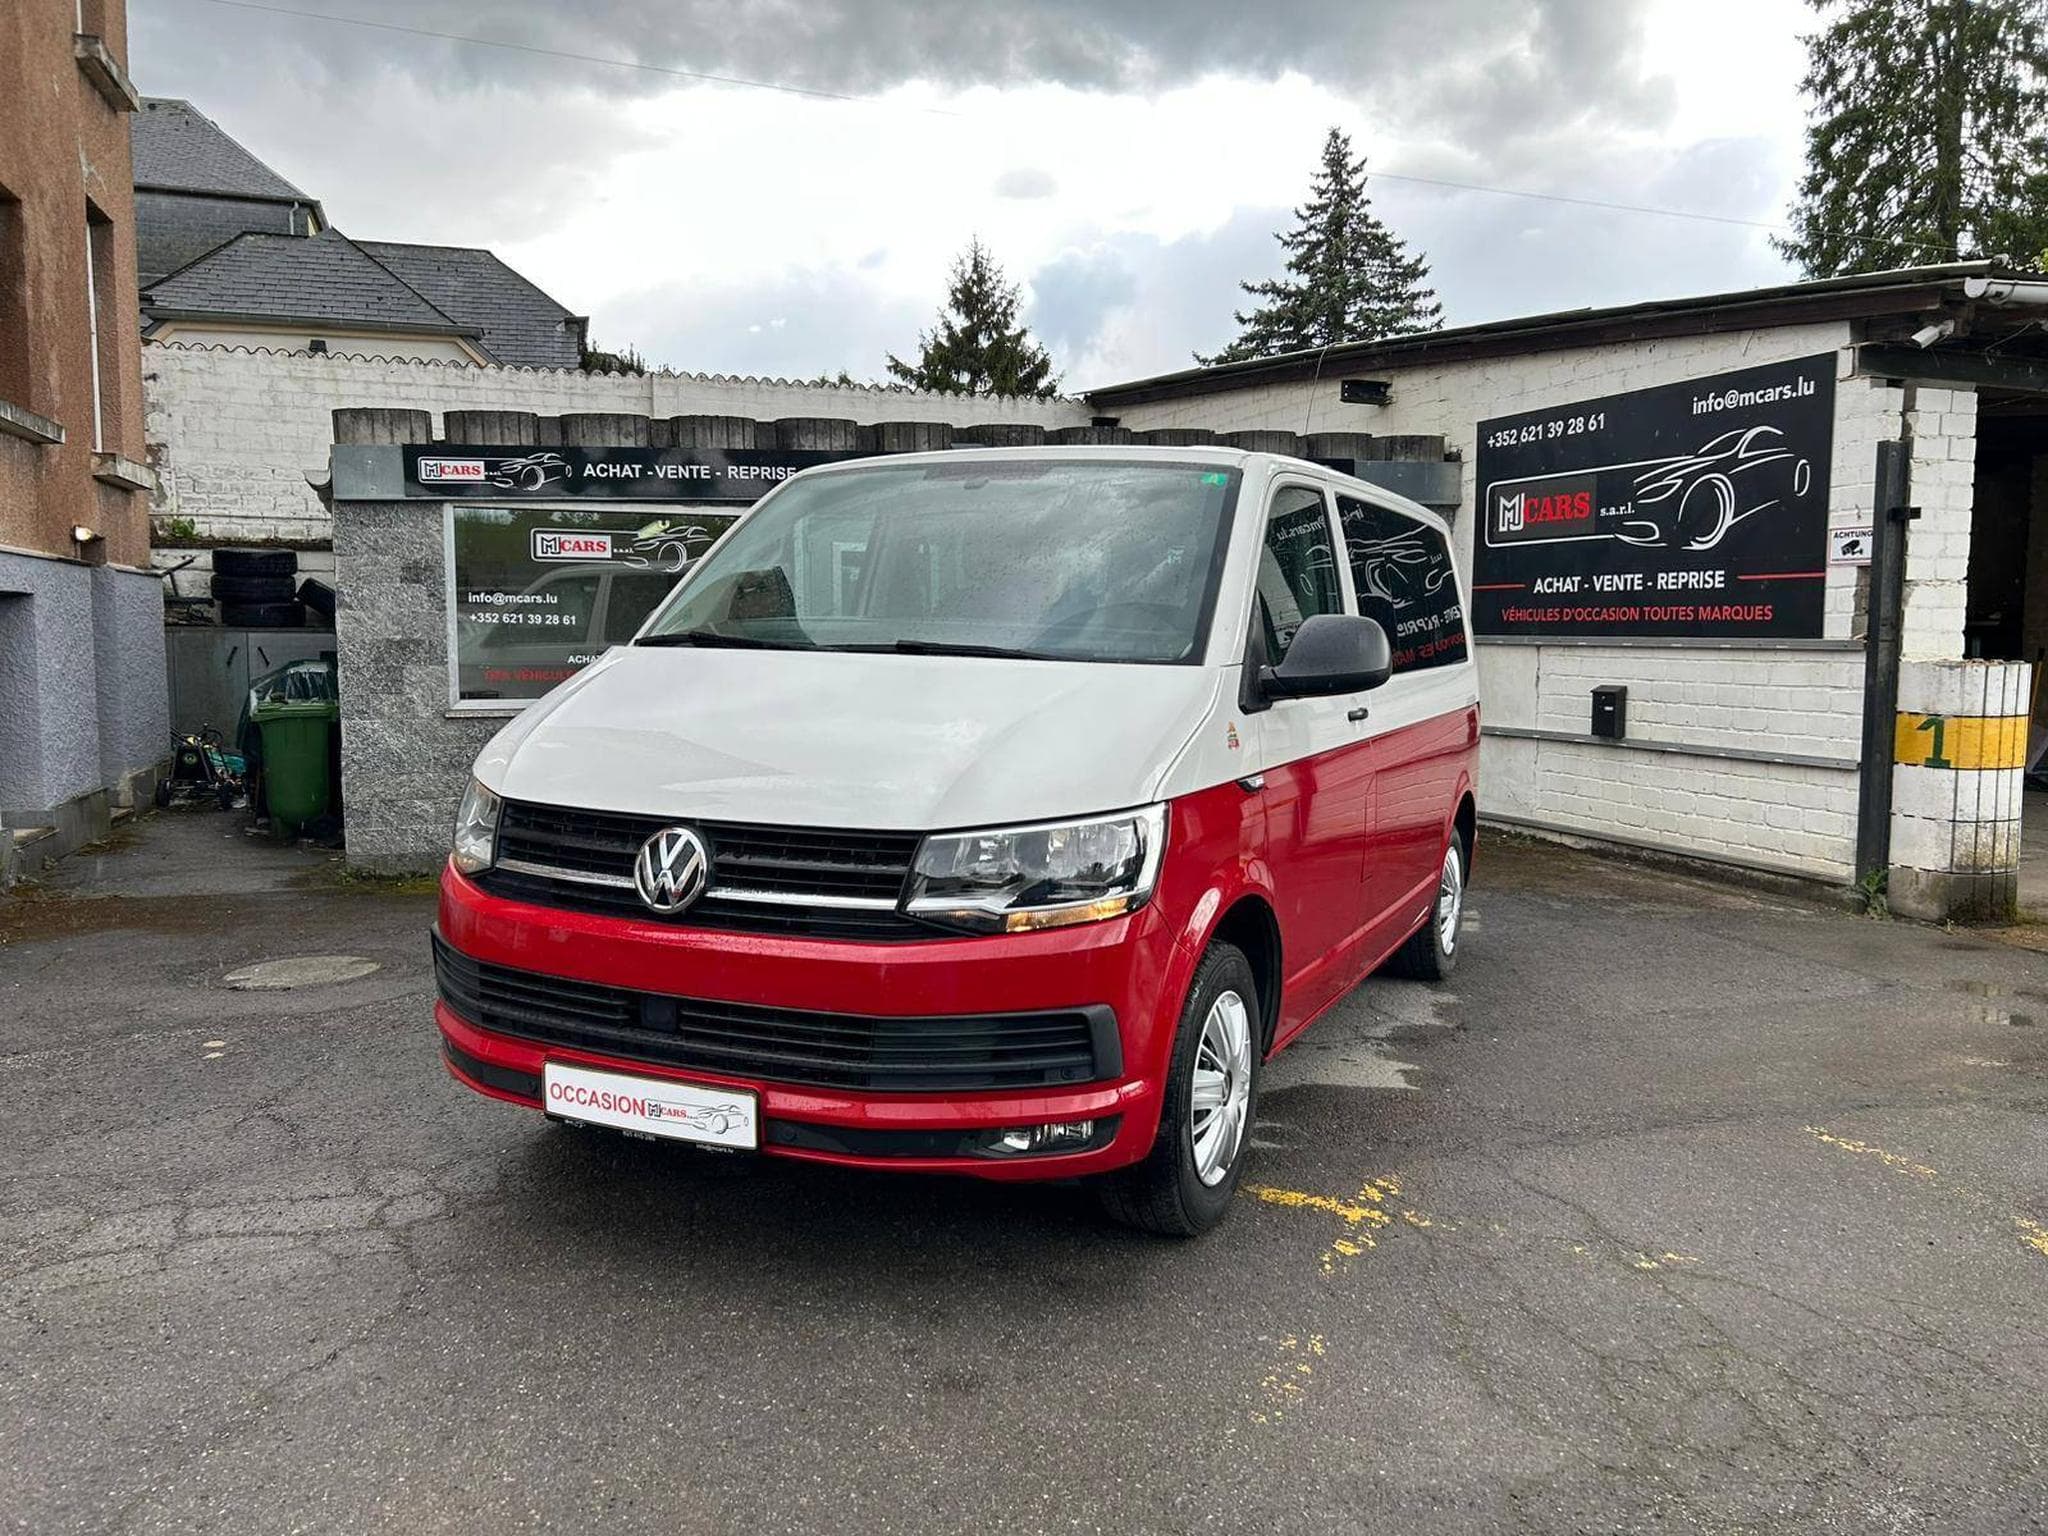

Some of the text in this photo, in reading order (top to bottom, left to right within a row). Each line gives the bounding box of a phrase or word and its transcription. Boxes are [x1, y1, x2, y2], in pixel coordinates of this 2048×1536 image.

[1692, 376, 1815, 415] info@mcars.lu
[1487, 412, 1605, 448] +352 621 39 28 61
[442, 463, 481, 476] CARS
[583, 463, 643, 478] ACHAT
[655, 464, 711, 479] VENTE
[728, 465, 797, 480] REPRISE
[1525, 491, 1590, 523] CARS
[1600, 502, 1635, 516] s.a.r.l.
[1834, 530, 1874, 539] ACHTUNG
[560, 540, 607, 553] CARS
[1533, 576, 1581, 594] ACHAT
[1593, 574, 1643, 592] VENTE
[1657, 570, 1725, 590] REPRISE
[468, 592, 558, 606] info@mcars.lu
[469, 613, 576, 625] +352 621 39 28 61
[1502, 605, 1773, 622] VÉHICULES D'OCCASION TOUTES MARQUES
[1916, 717, 1950, 769] 1
[550, 1082, 646, 1117] OCCASION
